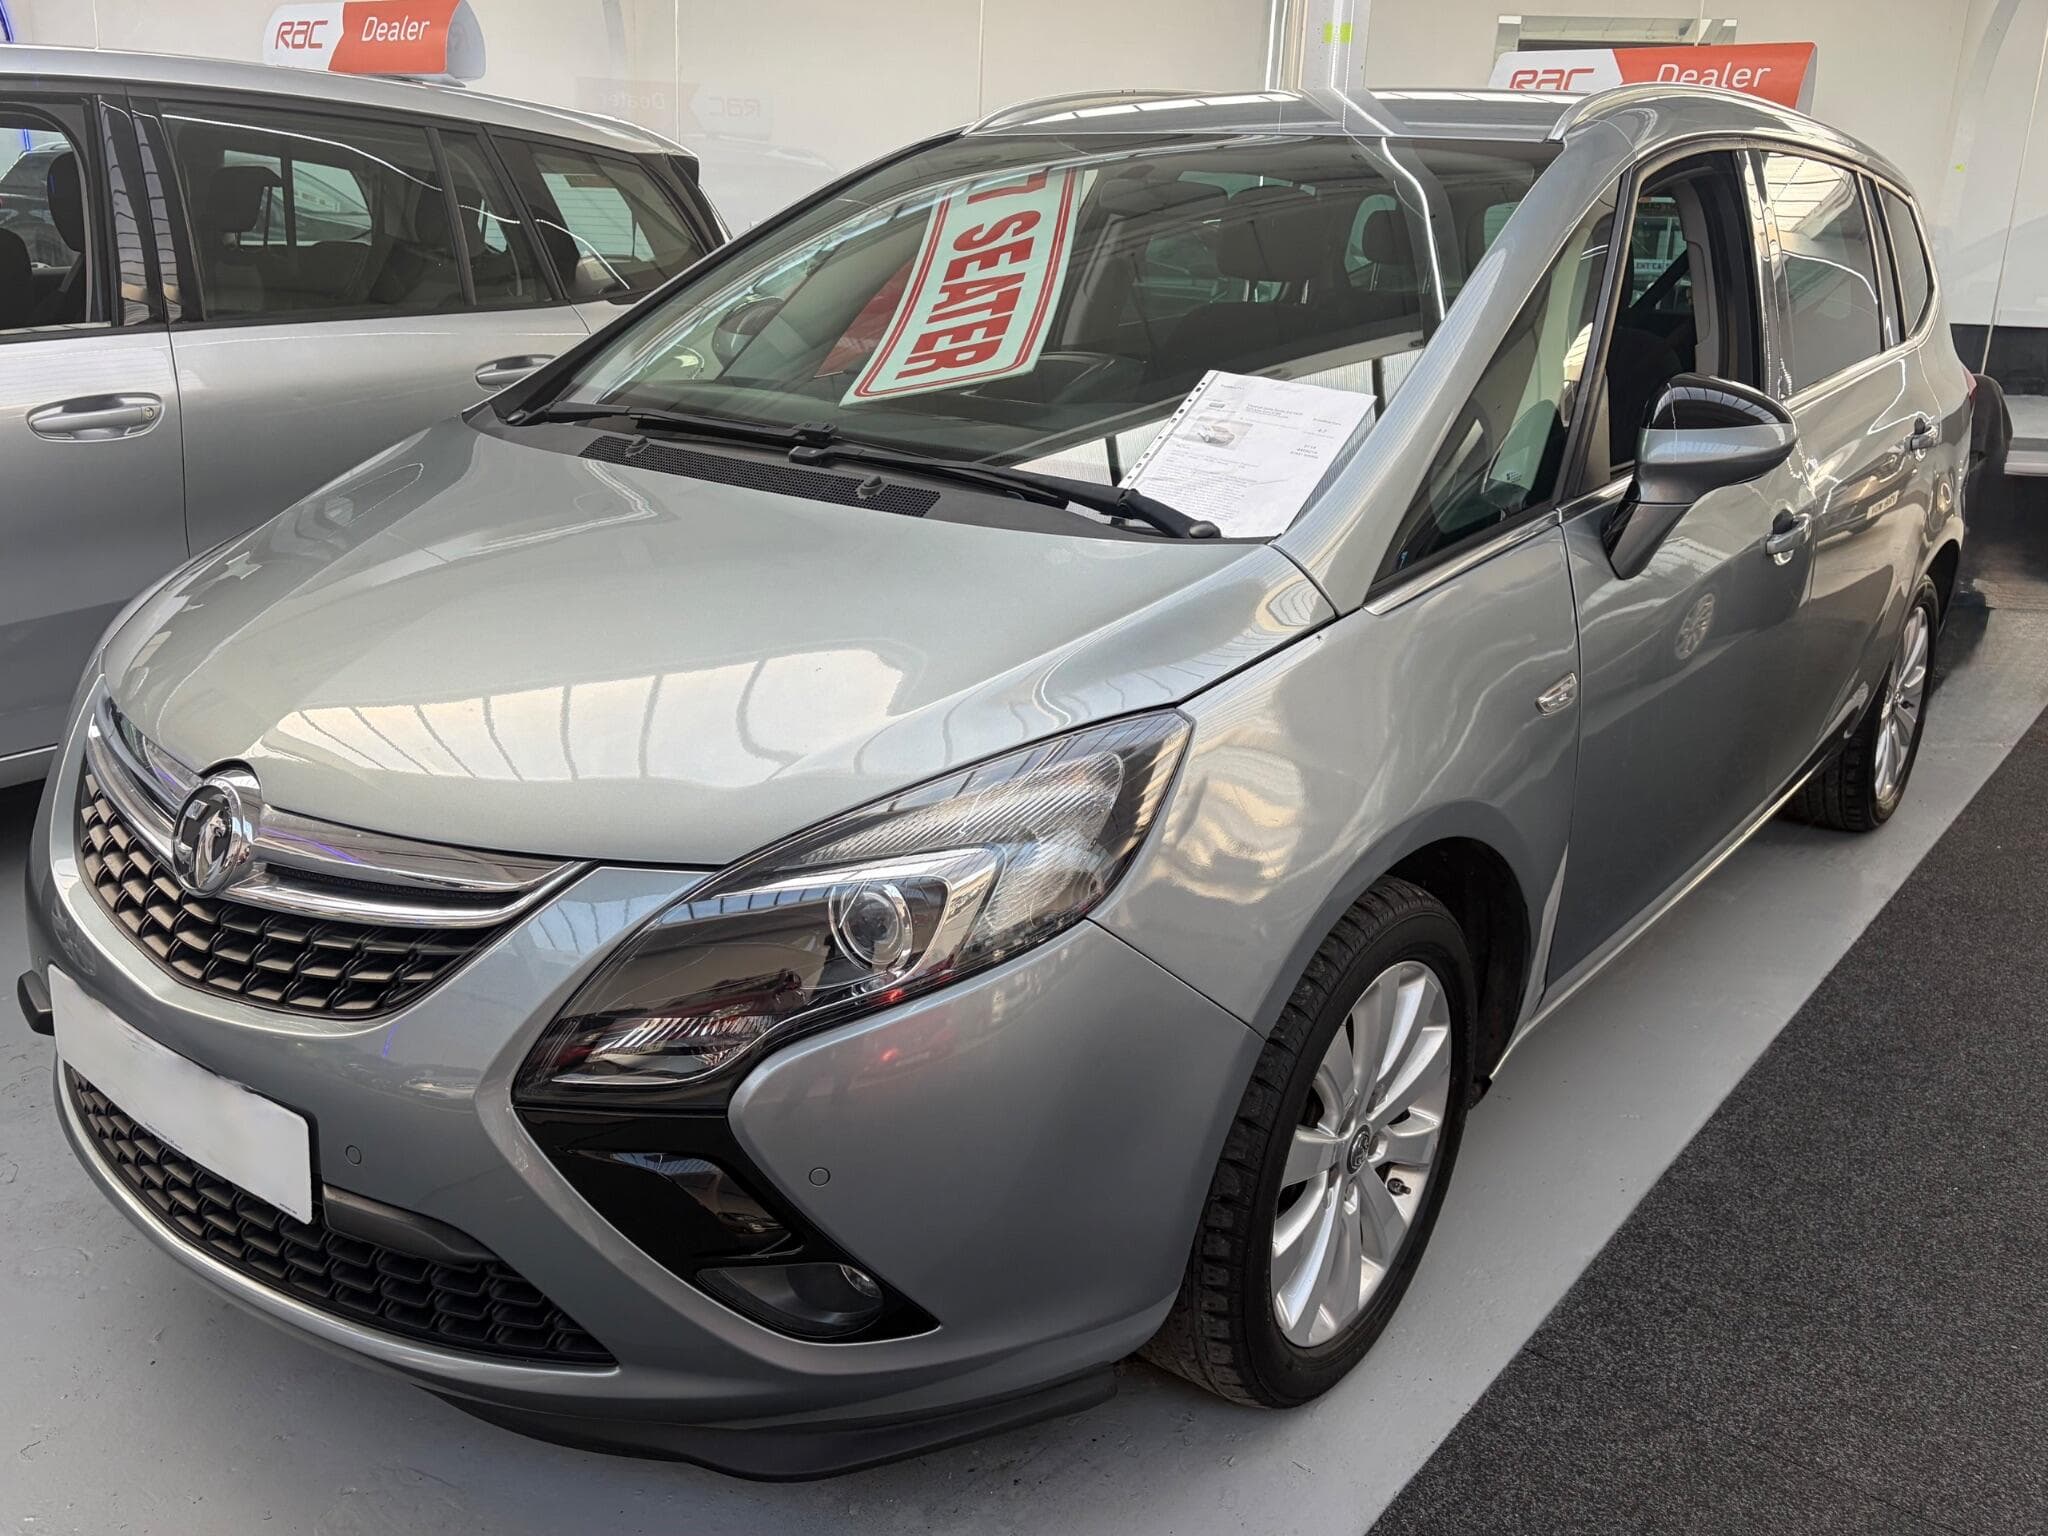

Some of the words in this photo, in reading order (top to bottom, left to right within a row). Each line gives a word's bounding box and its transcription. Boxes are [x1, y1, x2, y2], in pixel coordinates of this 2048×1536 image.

[361, 15, 430, 42] Dealer
[1656, 61, 1771, 88] Dealer
[895, 210, 1041, 380] SEATER
